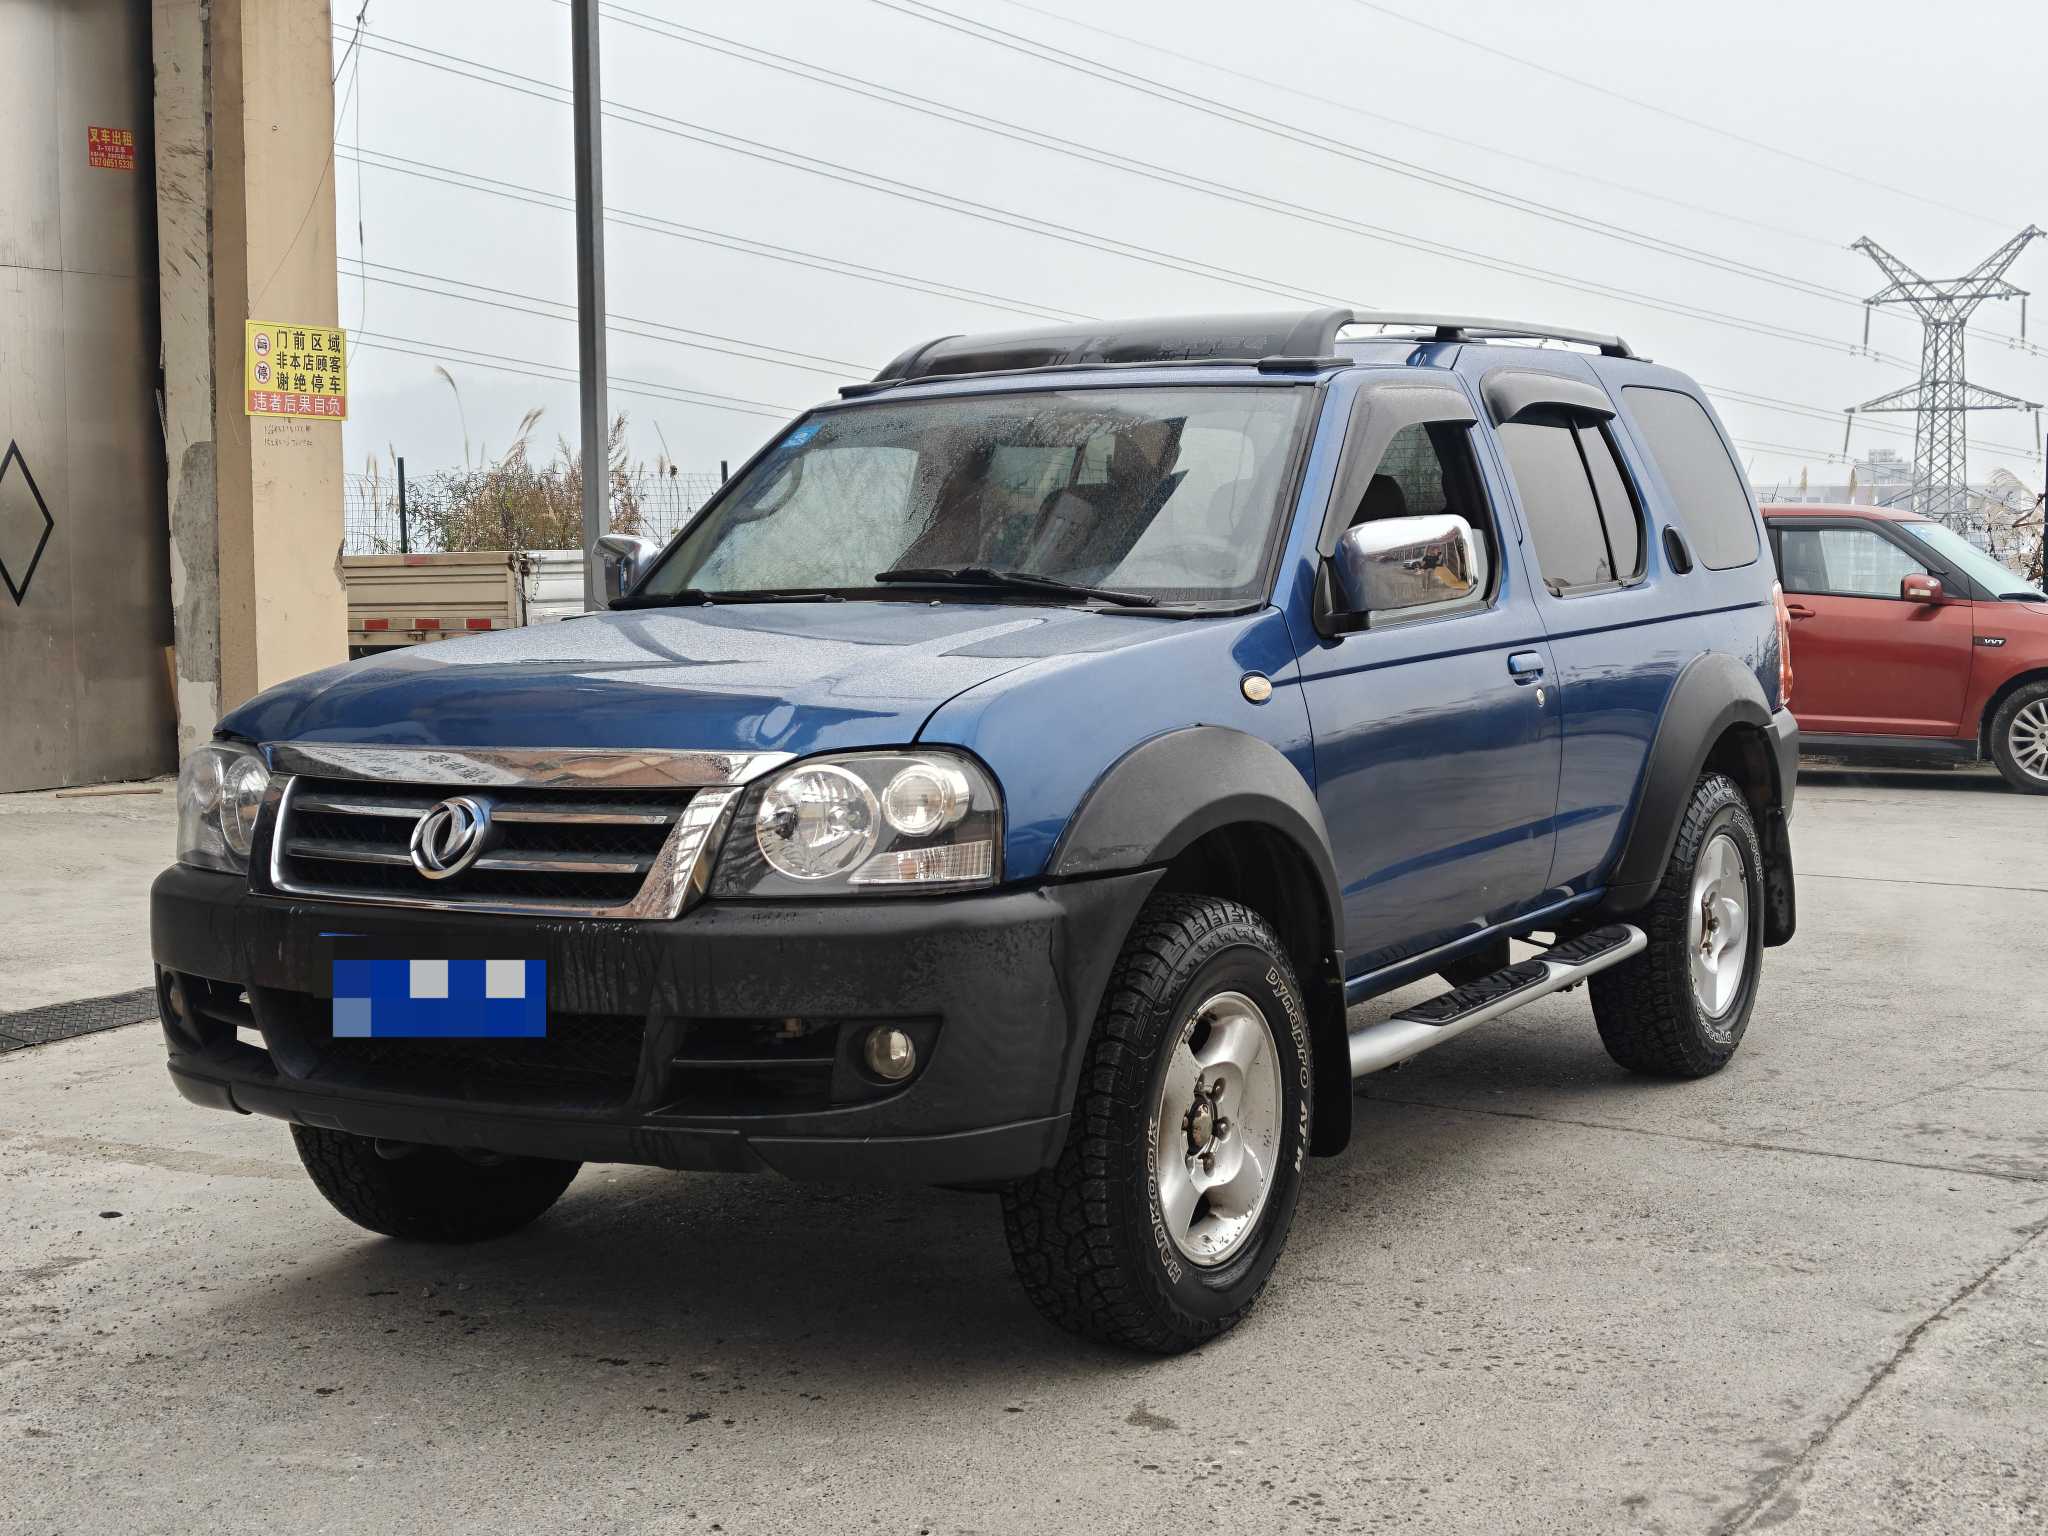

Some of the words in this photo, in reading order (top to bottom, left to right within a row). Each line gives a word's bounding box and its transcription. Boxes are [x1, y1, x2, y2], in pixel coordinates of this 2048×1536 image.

[90, 128, 133, 146] 叉车出租
[276, 329, 341, 354] 门前区域
[276, 351, 341, 374] 非本店顾客
[276, 371, 342, 394] 谢绝停车
[253, 391, 341, 416] 违者后果自负
